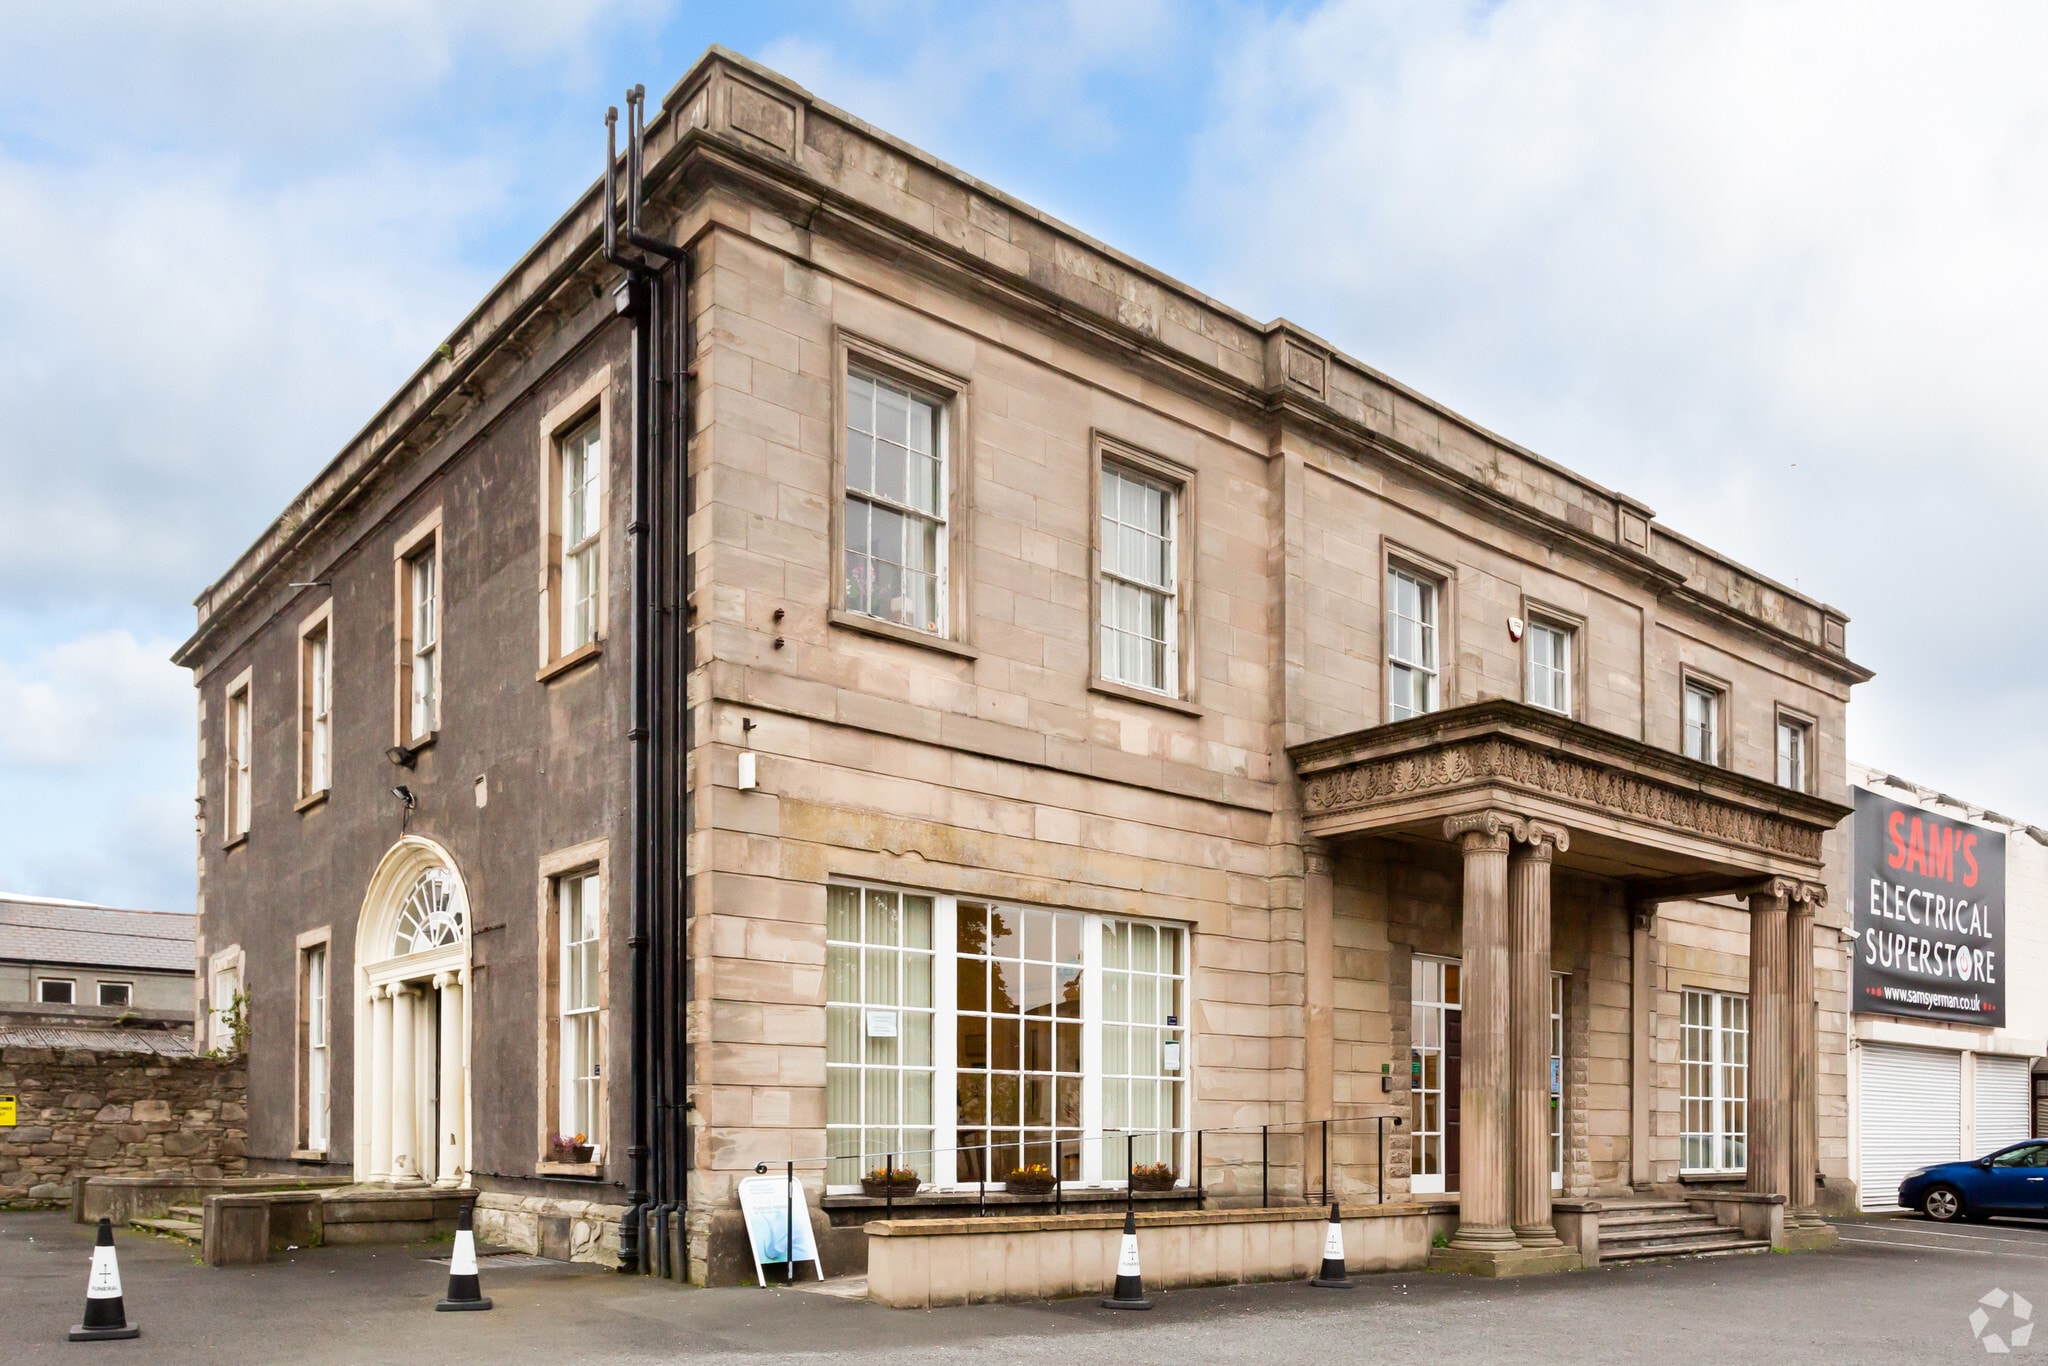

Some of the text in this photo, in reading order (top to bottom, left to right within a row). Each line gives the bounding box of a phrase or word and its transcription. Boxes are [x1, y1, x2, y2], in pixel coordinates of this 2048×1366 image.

[1888, 809, 1979, 888] SAM'S
[1870, 878, 1993, 939] ELECTRICAL
[1865, 927, 1996, 984] SUPERSTORE
[1883, 986, 1981, 1012] www.samsyerman.co.uk
